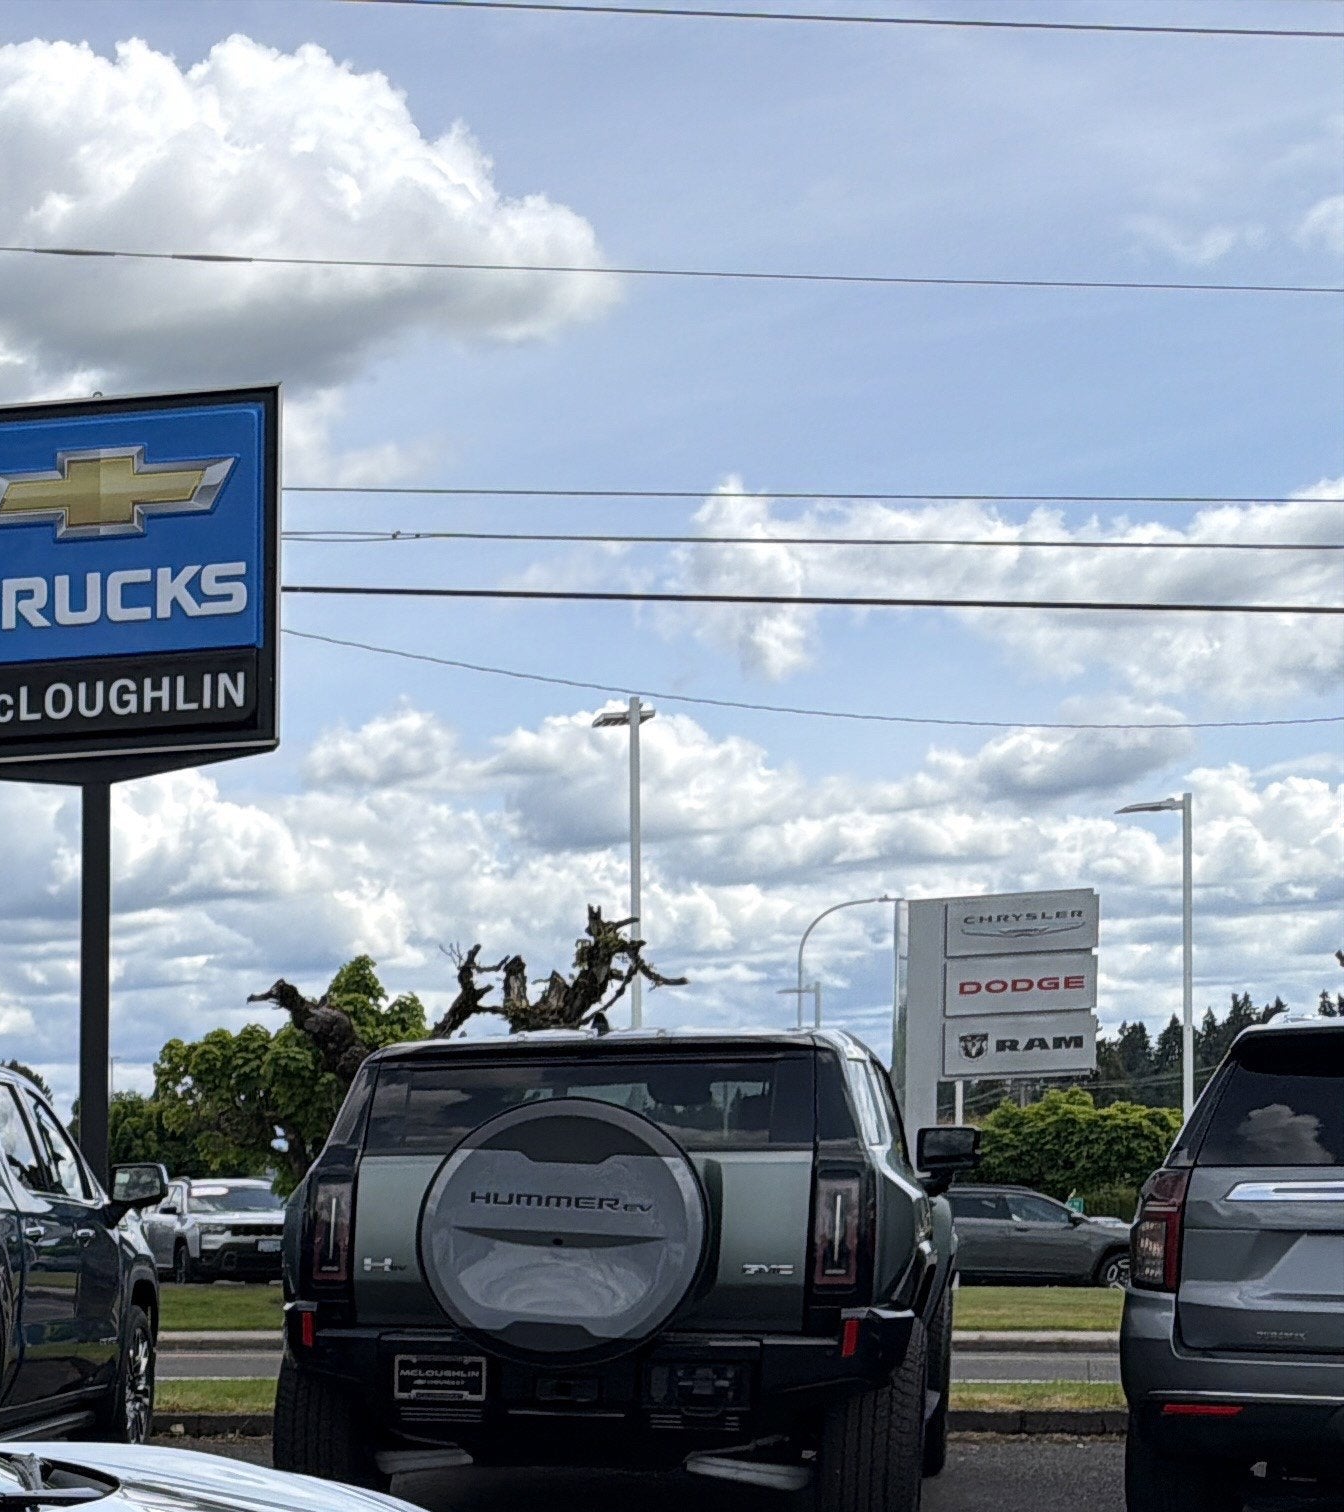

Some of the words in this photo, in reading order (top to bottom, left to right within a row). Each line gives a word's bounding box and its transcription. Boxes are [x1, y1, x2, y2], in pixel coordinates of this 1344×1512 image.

[963, 910, 1083, 925] CHRYSLER
[958, 975, 1085, 996] DODGE
[995, 1035, 1084, 1053] RAM
[470, 1190, 620, 1212] HUMMER
